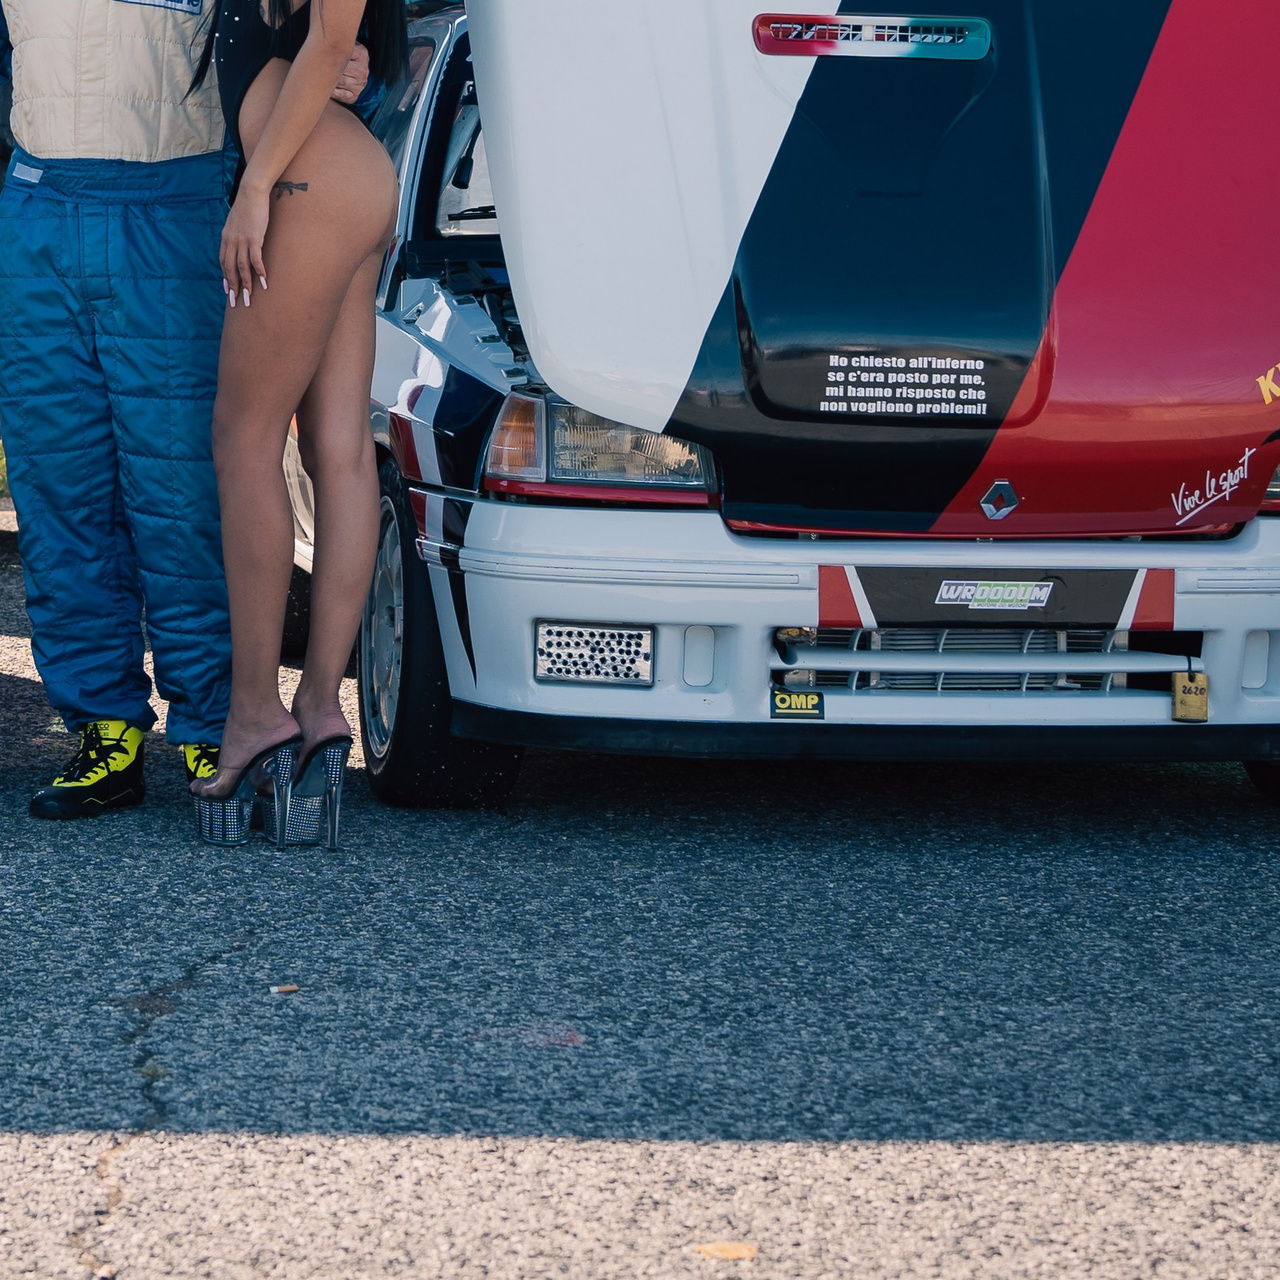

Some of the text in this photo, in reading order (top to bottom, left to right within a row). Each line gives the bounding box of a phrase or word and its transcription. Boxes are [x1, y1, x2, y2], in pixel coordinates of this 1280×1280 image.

[829, 355, 985, 370] Ho chiesto all'inferno
[827, 371, 986, 386] se c'era posto per me,
[825, 385, 986, 400] mi hanno risposto che
[820, 401, 987, 415] non vogliono problemi!
[1171, 482, 1204, 516] Vive
[1219, 447, 1257, 501] sport
[1182, 684, 1207, 696] 2620
[774, 693, 819, 709] OMP
